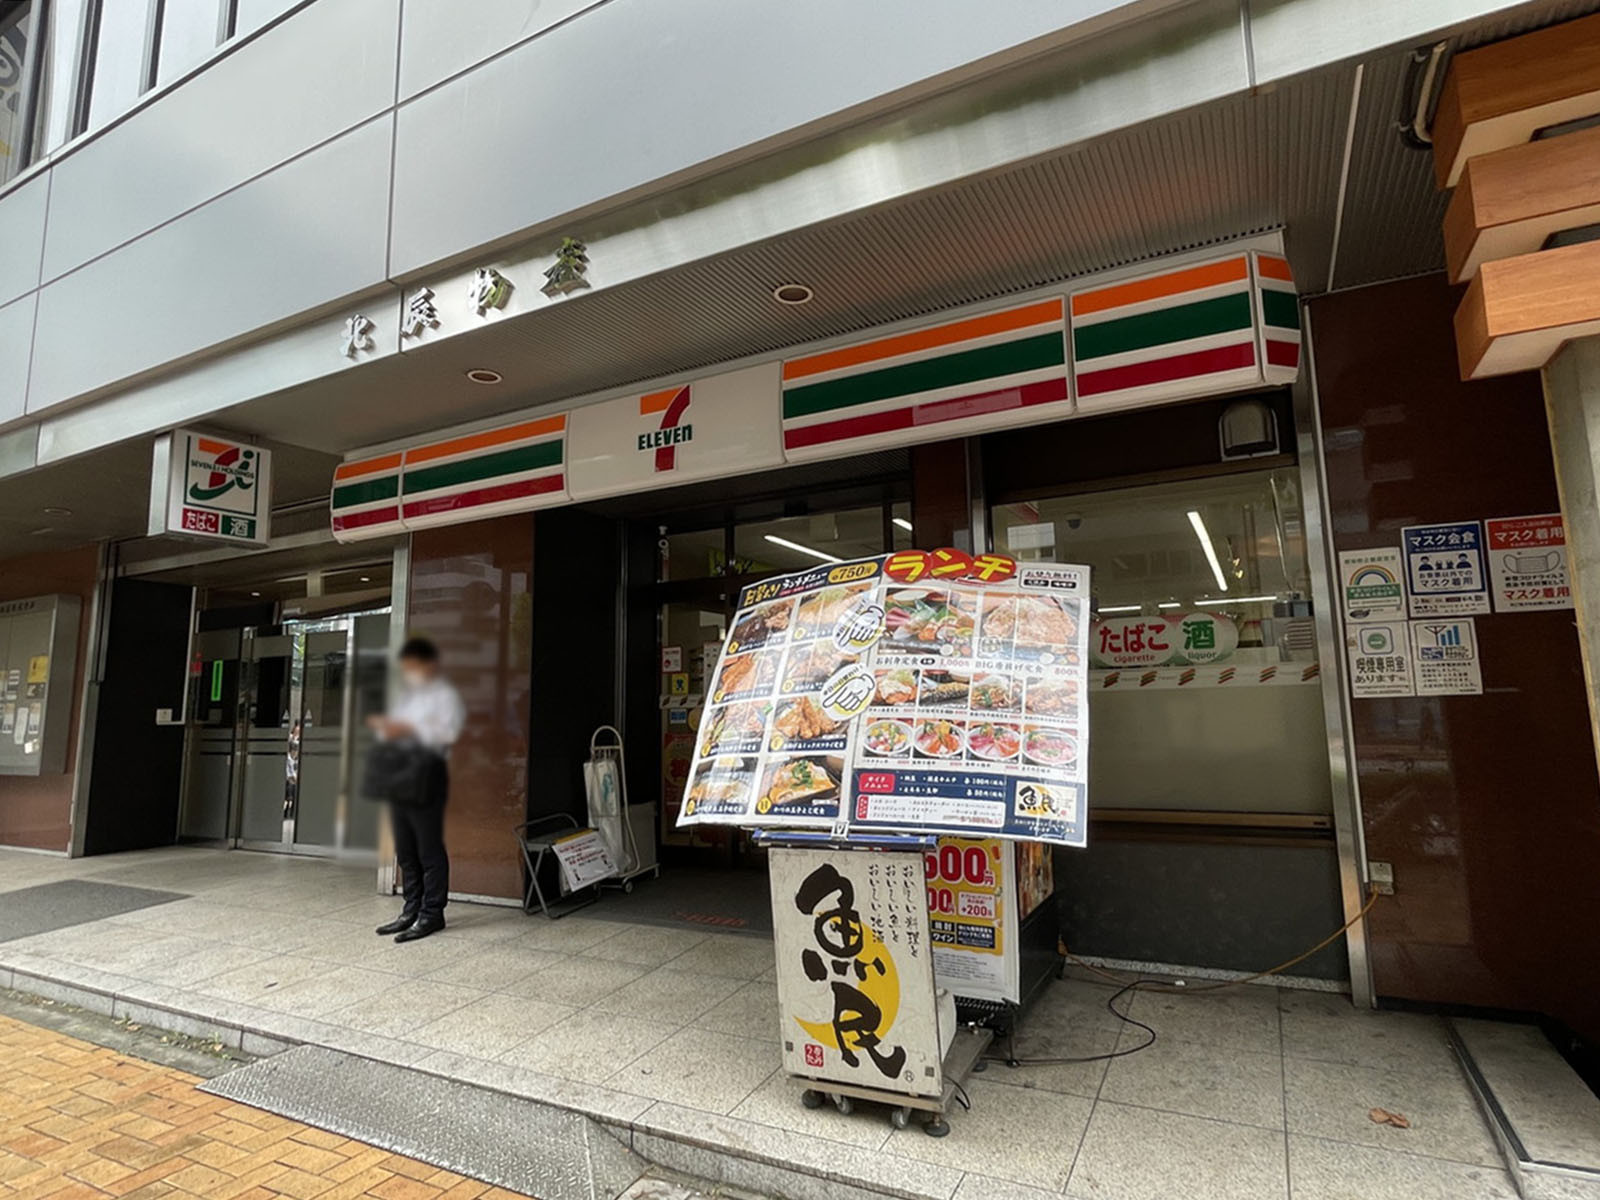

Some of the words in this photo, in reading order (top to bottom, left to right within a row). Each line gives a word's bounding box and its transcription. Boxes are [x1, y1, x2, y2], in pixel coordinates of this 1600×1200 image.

[186, 511, 216, 532] たばこ
[230, 518, 249, 536] 酒
[1409, 530, 1475, 547] マスク会食
[1494, 527, 1564, 542] マスク着用
[889, 550, 1012, 581] ランチ
[1420, 577, 1473, 587] マスク着用
[1503, 586, 1570, 600] マスク着用
[1100, 623, 1170, 654] たばこ
[1182, 619, 1216, 650] 酒
[1355, 655, 1406, 674] 喫煙専用室
[932, 933, 954, 943] ワイン
[795, 863, 907, 1080] 魚民
